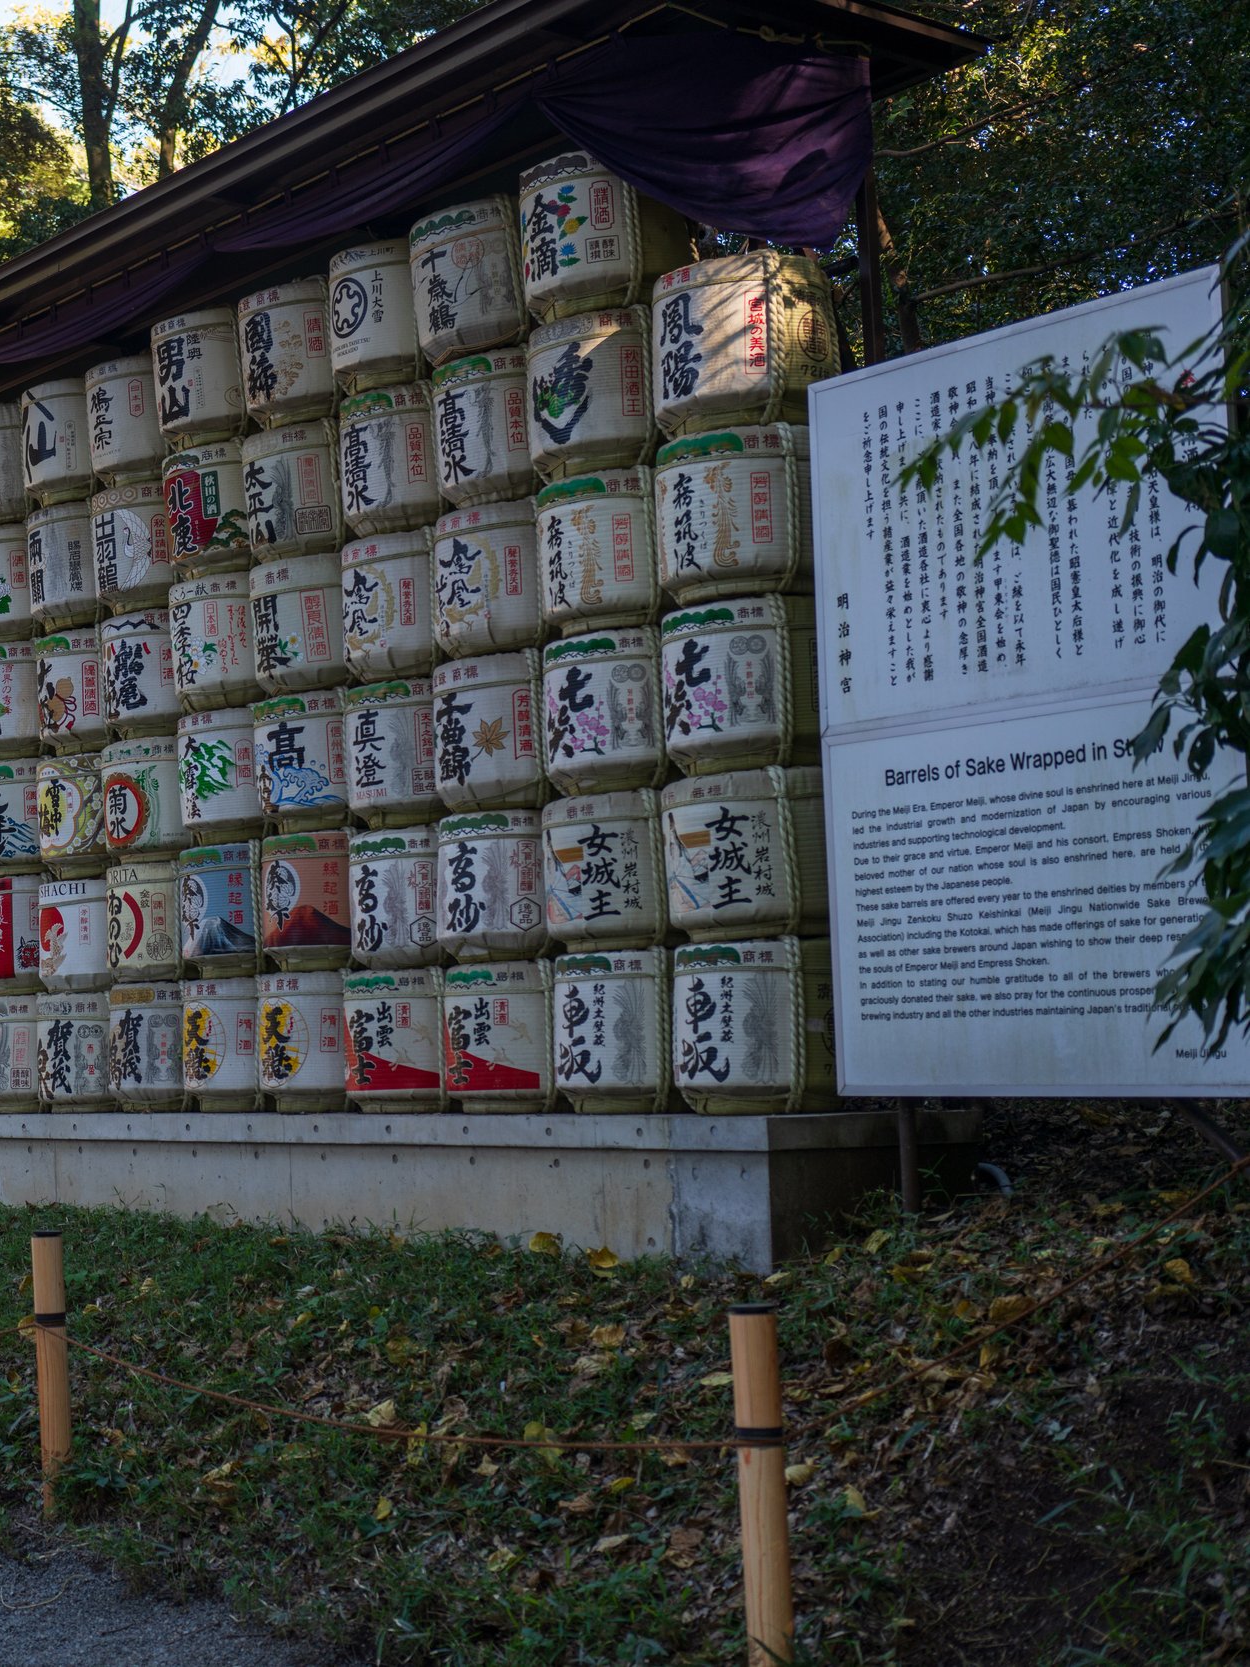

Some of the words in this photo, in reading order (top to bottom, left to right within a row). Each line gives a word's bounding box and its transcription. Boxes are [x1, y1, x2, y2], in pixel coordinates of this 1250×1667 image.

[598, 312, 633, 327] 商標
[748, 297, 766, 368] 宮城の美酒
[394, 391, 424, 407] 商標
[507, 392, 525, 444] 品質本位
[408, 427, 424, 477] 品質本位
[744, 434, 780, 449] 商標
[204, 475, 218, 515] 秋田の酒
[862, 410, 875, 541] をご祈念申し上げます
[245, 461, 277, 545] 太平山
[738, 606, 765, 619] 商標
[836, 592, 853, 694] 明治神宮
[517, 694, 533, 751] 芳醇清酒
[330, 726, 344, 780] 信州清酒
[884, 763, 940, 787] Barrels
[943, 760, 962, 779] of
[965, 754, 1006, 777] Sake
[1009, 743, 1087, 772] Wrapped
[1092, 742, 1108, 761] in
[1113, 736, 1164, 758] Stw
[108, 785, 132, 840] 菊水
[356, 788, 388, 801] MASUMI
[851, 810, 876, 819] During
[878, 807, 891, 816] the
[892, 805, 910, 815] Meiji
[930, 800, 964, 811] Emperor
[988, 794, 1016, 804] whose
[1018, 791, 1043, 801] divine
[1045, 787, 1063, 798] soul
[1066, 787, 1073, 796] is
[1075, 781, 1120, 795] enshrined
[1122, 780, 1143, 789] here
[1146, 777, 1154, 787] at
[1157, 774, 1178, 786] Meiji
[852, 825, 864, 835] led
[868, 824, 882, 833] the
[886, 819, 922, 831] industrial
[927, 816, 955, 829] growth
[960, 814, 976, 823] and
[981, 808, 1041, 821] modernization
[1046, 805, 1056, 814] of
[1062, 803, 1089, 814] Japan
[1094, 800, 1106, 811] by
[1111, 794, 1170, 808] encouraging
[1176, 790, 1212, 801] various
[705, 806, 752, 910] 女城主
[853, 839, 890, 850] industries
[891, 837, 906, 846] and
[907, 833, 950, 846] supporting
[952, 827, 1006, 840] technological
[1008, 821, 1065, 835] development.
[322, 861, 340, 916] 縁起酒
[577, 824, 621, 921] 女城主
[227, 872, 245, 925] 縁起酒
[856, 918, 874, 928] Meiji
[880, 917, 901, 927] Jingu
[907, 914, 941, 924] Zenkoku
[947, 912, 972, 921] Shuzo
[978, 908, 1021, 919] Keishinkai
[1027, 906, 1051, 918] (Meiji
[1058, 904, 1082, 915] Jingu
[1089, 900, 1140, 912] Nationwide
[1147, 898, 1170, 908] Sake
[1178, 896, 1206, 906] Brewe
[495, 971, 525, 983] 島根
[742, 951, 775, 964] 商標
[397, 976, 425, 987] 島根
[376, 1001, 394, 1048] 出雲
[473, 997, 491, 1047] 出雲
[861, 1012, 891, 1021] brewing
[892, 1010, 924, 1020] industry
[925, 1010, 940, 1018] and
[942, 1009, 951, 1018] all
[953, 1009, 966, 1017] the
[968, 1008, 990, 1017] other
[992, 1007, 1033, 1016] industries
[1035, 1005, 1084, 1016] maintaining
[1086, 1004, 1122, 1015] Japan's
[1175, 1048, 1198, 1059] Meiji
